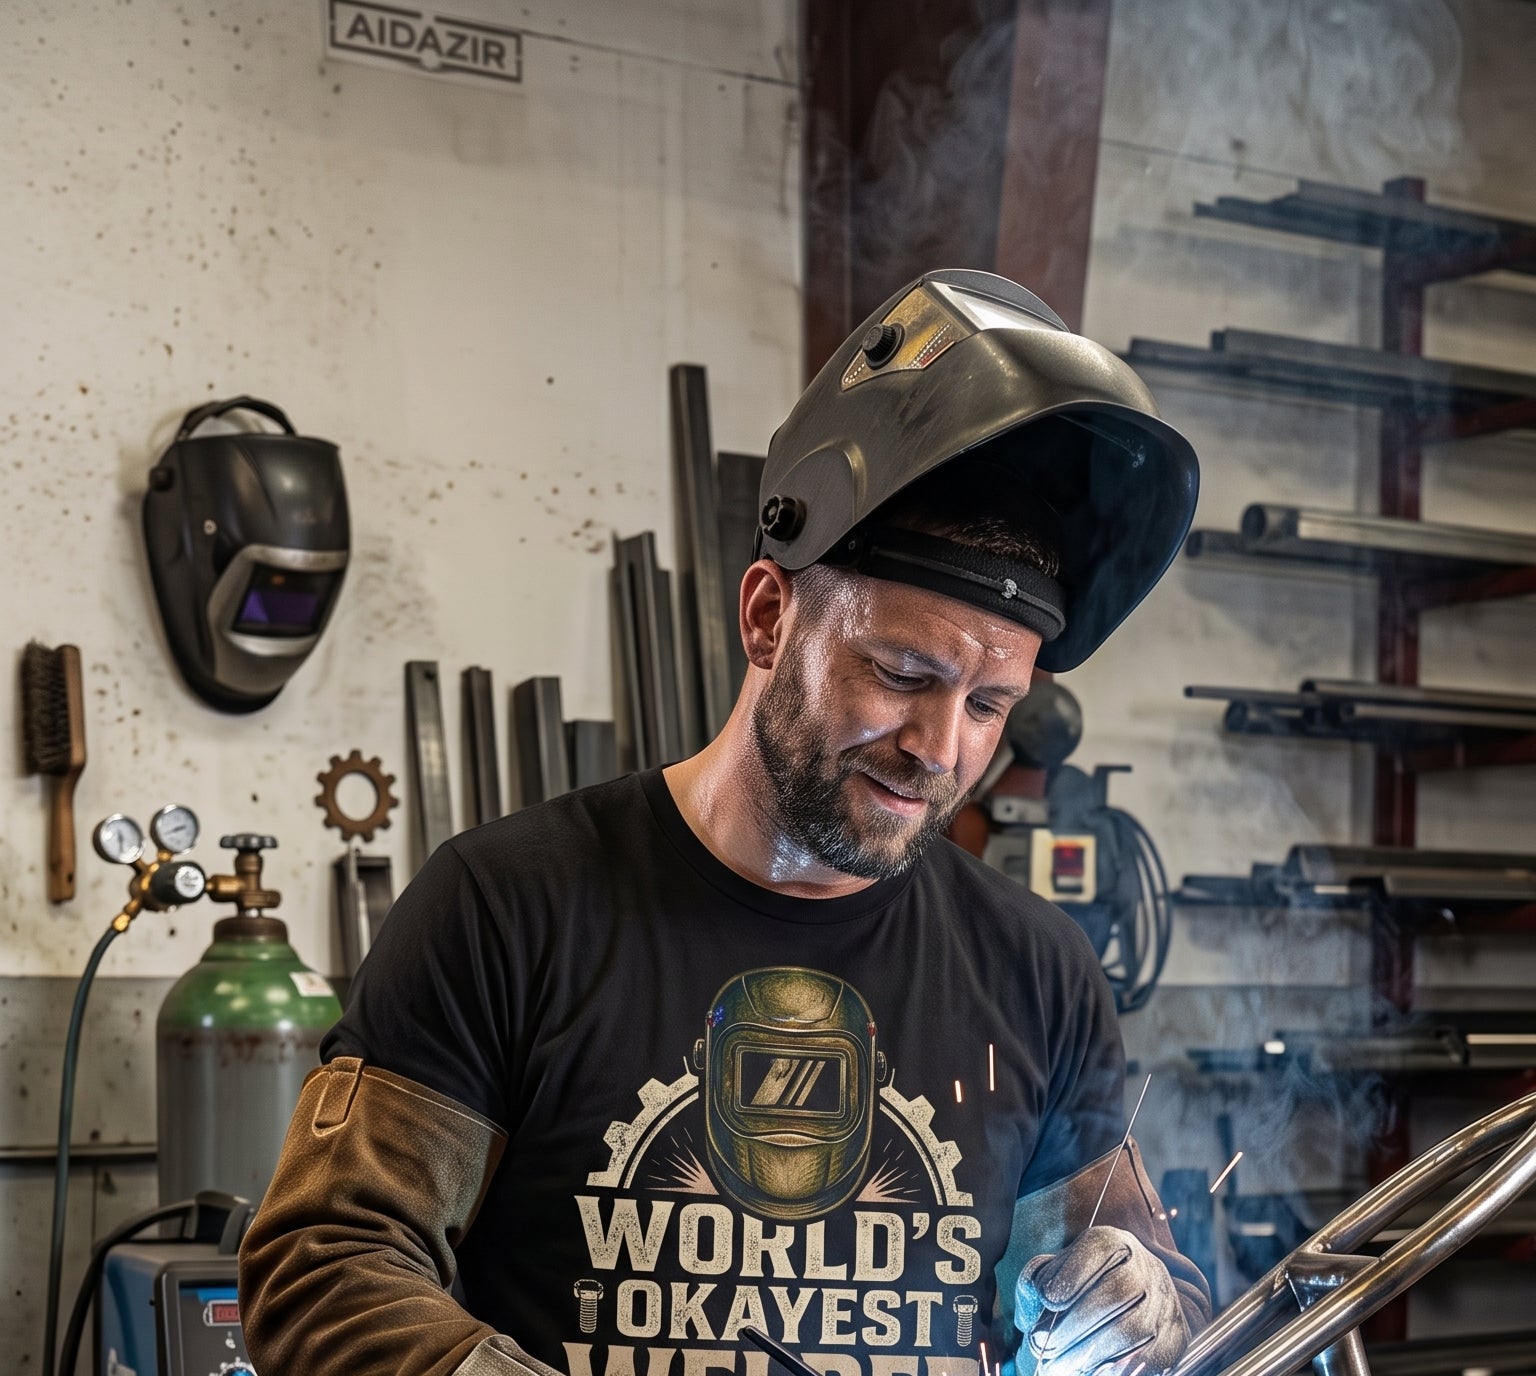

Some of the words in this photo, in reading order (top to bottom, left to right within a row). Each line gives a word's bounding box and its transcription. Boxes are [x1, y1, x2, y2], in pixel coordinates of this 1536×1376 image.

[347, 13, 506, 69] AIDAZIR
[574, 1195, 981, 1285] WORLD'S
[616, 1279, 943, 1348] OKAYEST
